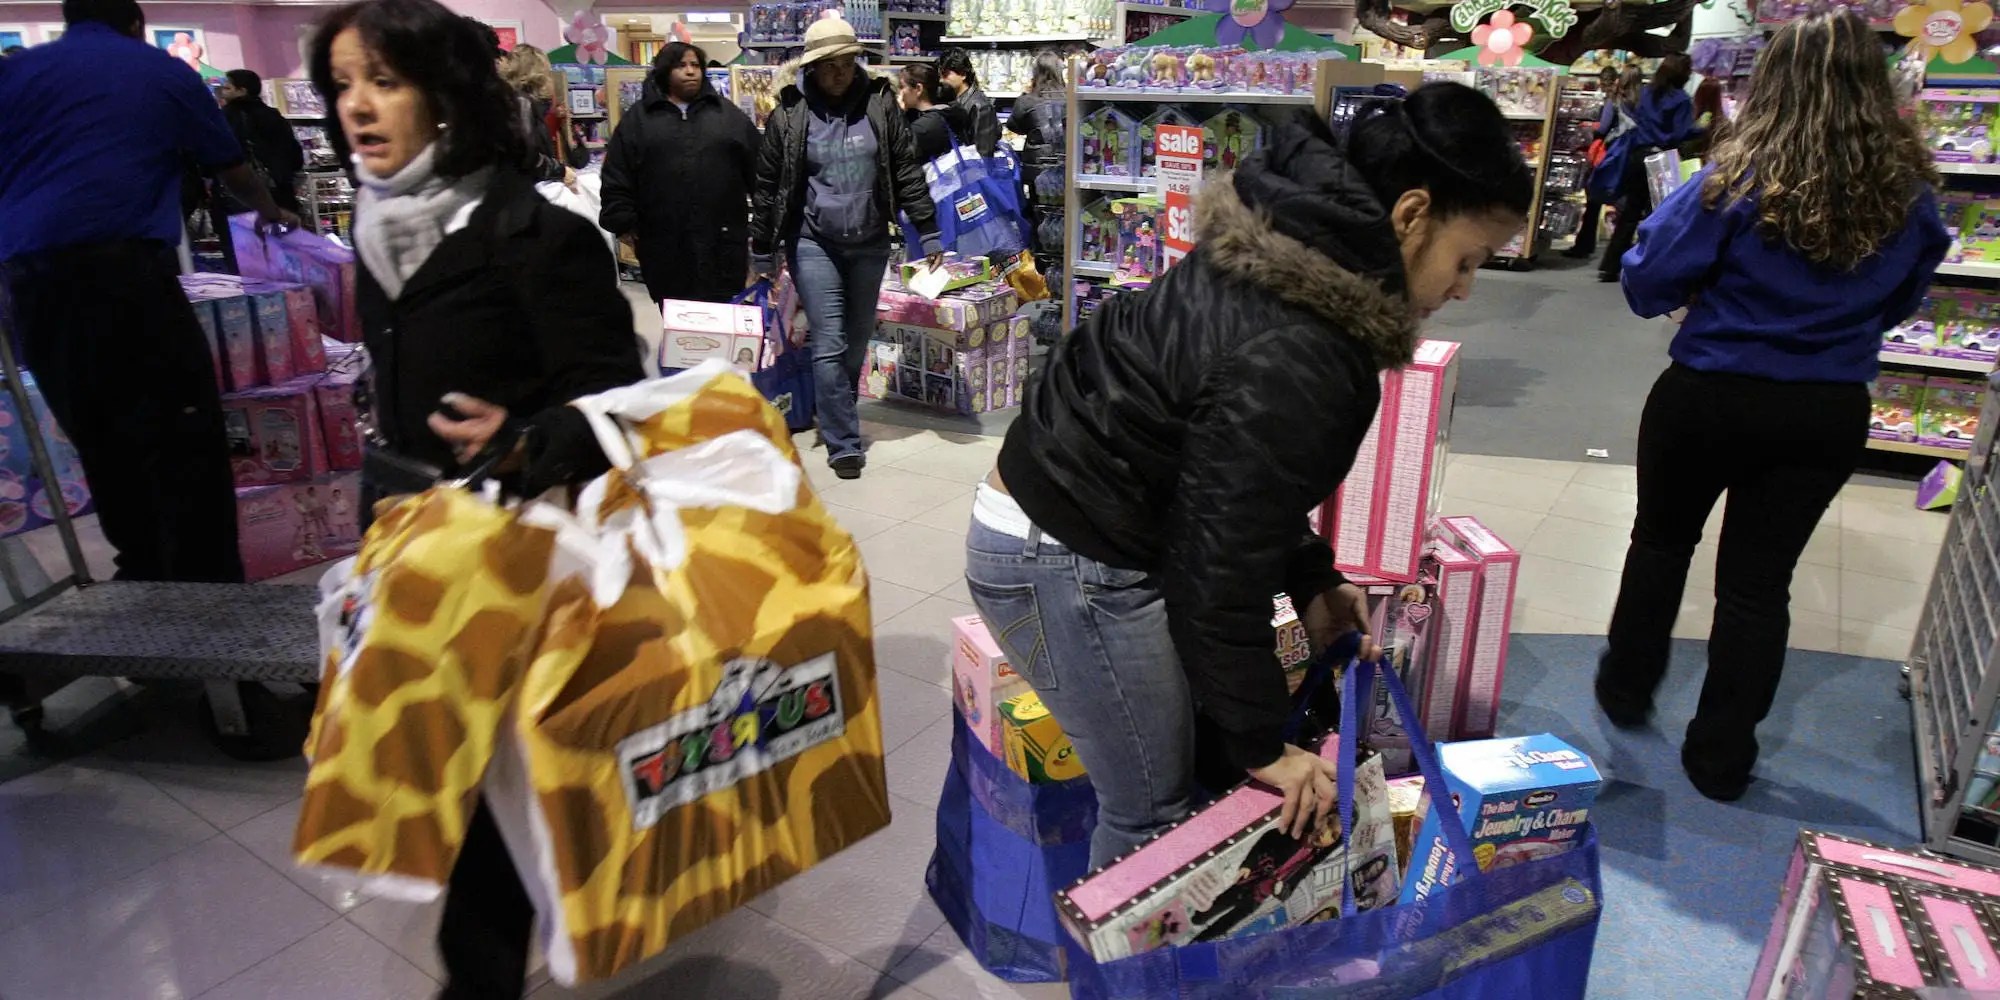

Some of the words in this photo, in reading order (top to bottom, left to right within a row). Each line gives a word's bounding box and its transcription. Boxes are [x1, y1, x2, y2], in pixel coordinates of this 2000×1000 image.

[1158, 129, 1199, 154] sale
[1168, 205, 1194, 243] sa
[776, 681, 831, 731] US
[1475, 814, 1534, 838] Jewelry
[1532, 811, 1545, 830] &
[1545, 808, 1588, 828] Charm
[1416, 837, 1447, 897] Jewelry
